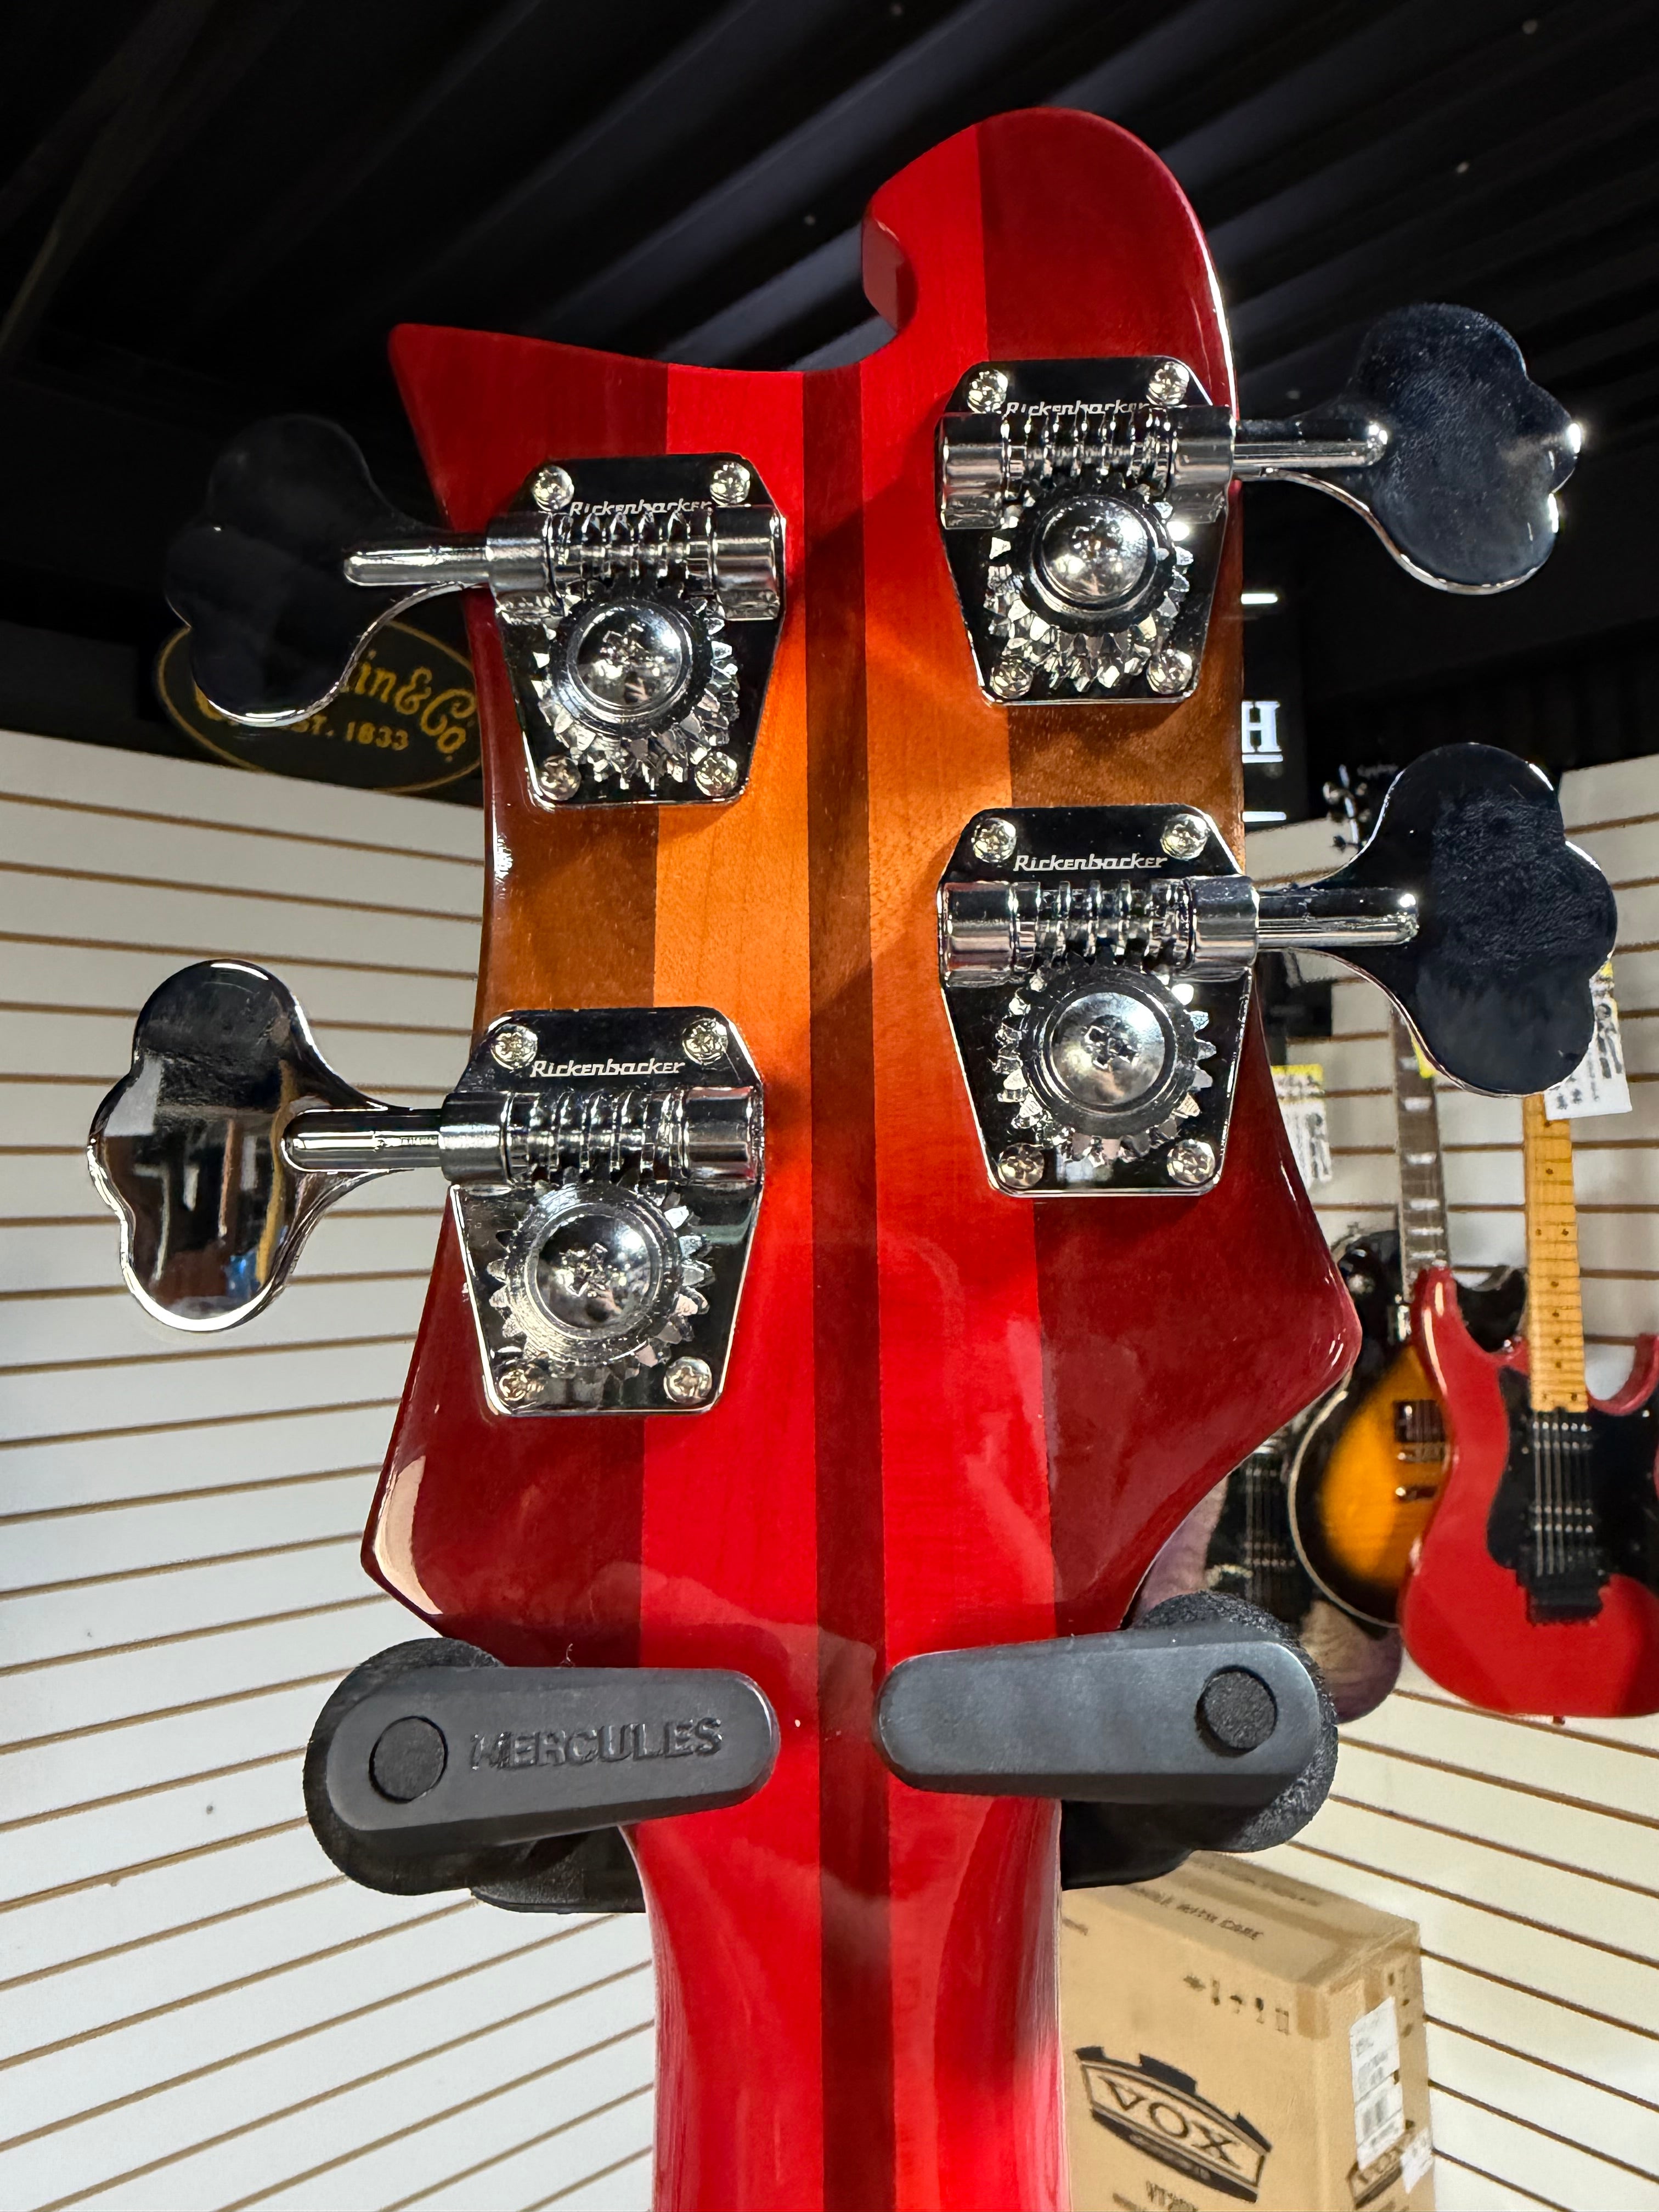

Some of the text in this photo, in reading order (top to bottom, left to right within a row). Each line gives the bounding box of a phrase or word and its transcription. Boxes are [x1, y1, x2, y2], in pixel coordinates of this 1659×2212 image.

[346, 721, 409, 751] 1833
[1013, 853, 1168, 871] Rickenbacker
[529, 1058, 685, 1077] Rickenbacker
[469, 1717, 723, 1770] HERCULES
[1101, 2075, 1241, 2169] VOX
